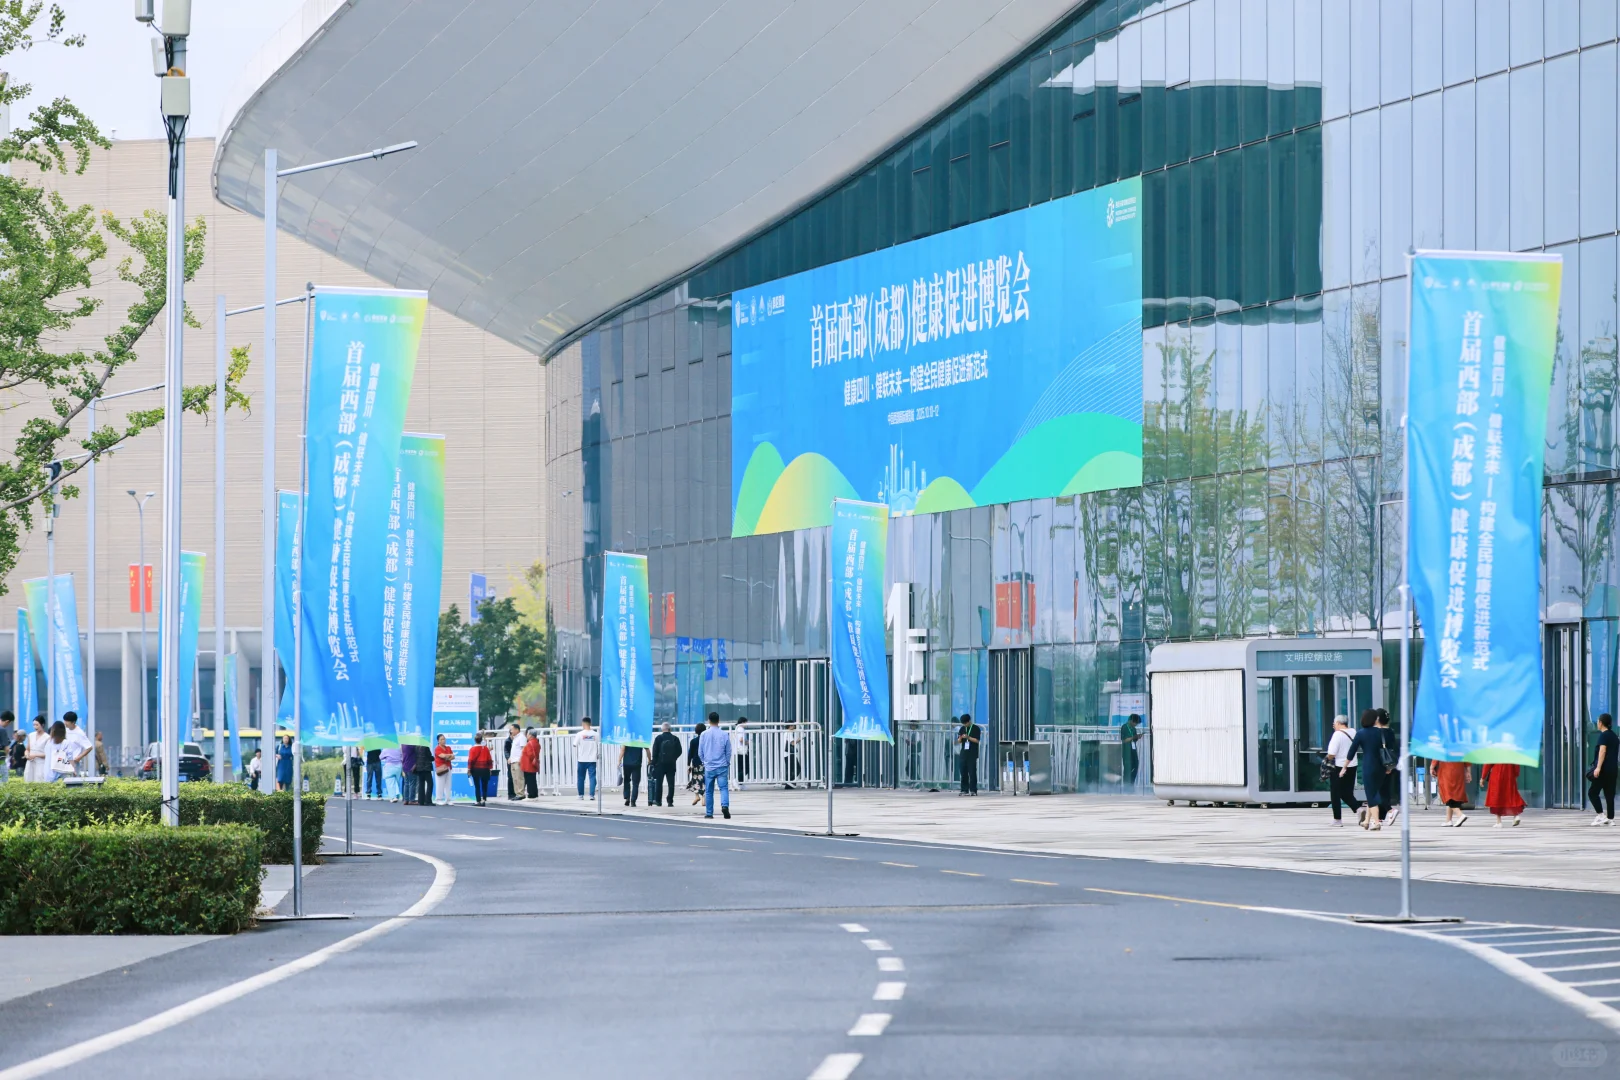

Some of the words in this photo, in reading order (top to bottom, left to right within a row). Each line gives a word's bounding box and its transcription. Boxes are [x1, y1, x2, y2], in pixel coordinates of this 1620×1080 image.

[810, 250, 1030, 369] 首届西部(成都)健康促进博览会
[328, 341, 365, 681] 首届西部（成都）健康促进博览会
[1439, 311, 1484, 689] 首届西部（成都）健康促进博览会
[1285, 652, 1343, 662] 文明控烟设施
